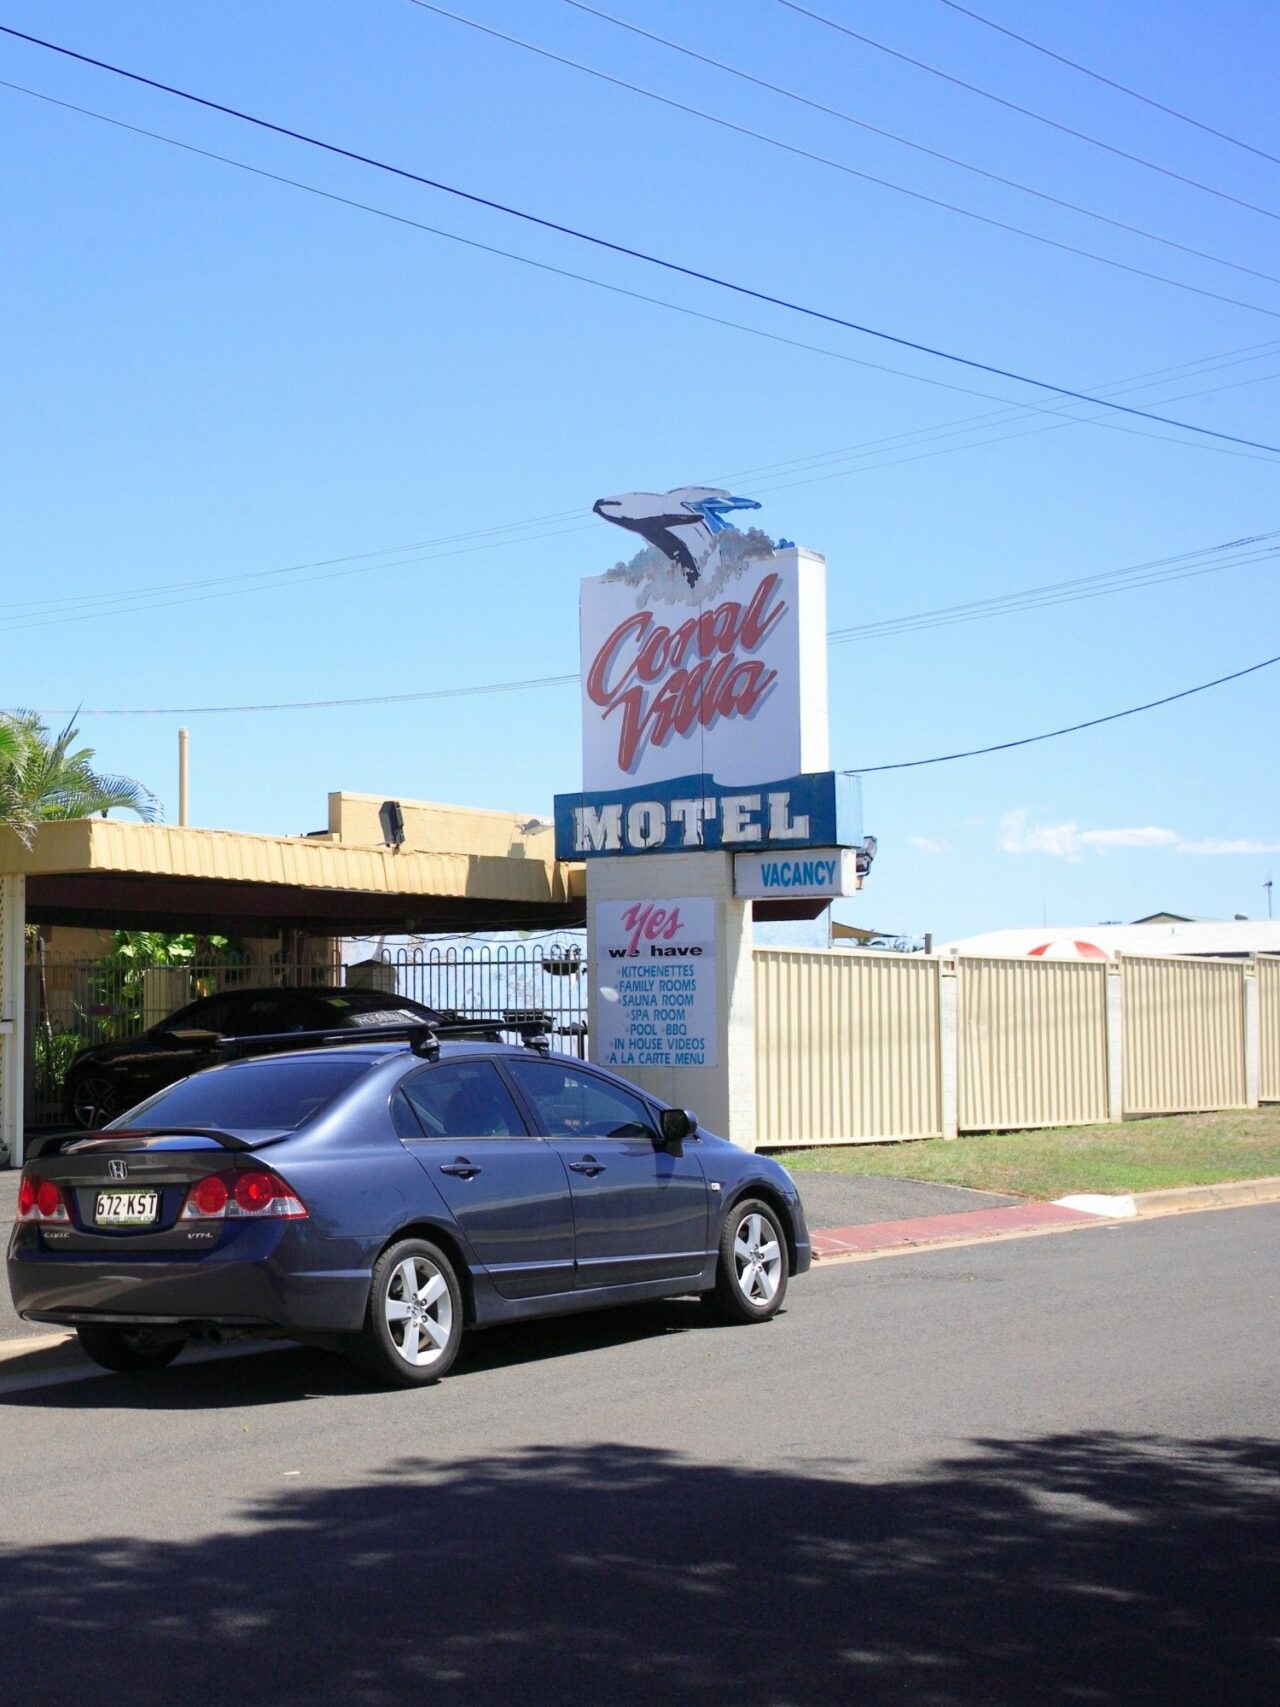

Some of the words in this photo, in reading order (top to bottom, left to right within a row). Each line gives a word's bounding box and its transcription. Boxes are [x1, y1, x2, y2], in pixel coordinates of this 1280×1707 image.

[586, 572, 787, 708] Coral
[604, 652, 780, 773] Villa
[575, 791, 810, 852] MOTEL
[761, 860, 836, 888] VACANCY
[608, 948, 641, 958] we
[650, 944, 704, 957] have
[621, 964, 695, 978] KITCHENETTES
[619, 980, 655, 993] FAMILY
[659, 979, 697, 992] ROOMS
[622, 994, 658, 1007] SAUNA
[662, 994, 694, 1006] ROOM
[631, 1009, 650, 1021] SPA
[654, 1008, 686, 1021] ROOM
[630, 1023, 658, 1036] POOL
[665, 1023, 688, 1036] BBQ
[614, 1038, 625, 1050] IN
[629, 1038, 663, 1050] HOUSE
[667, 1037, 706, 1050] VIDEOS
[609, 1052, 618, 1065] A
[621, 1052, 635, 1065] LA
[638, 1052, 671, 1065] CARTE
[675, 1052, 705, 1065] MENU
